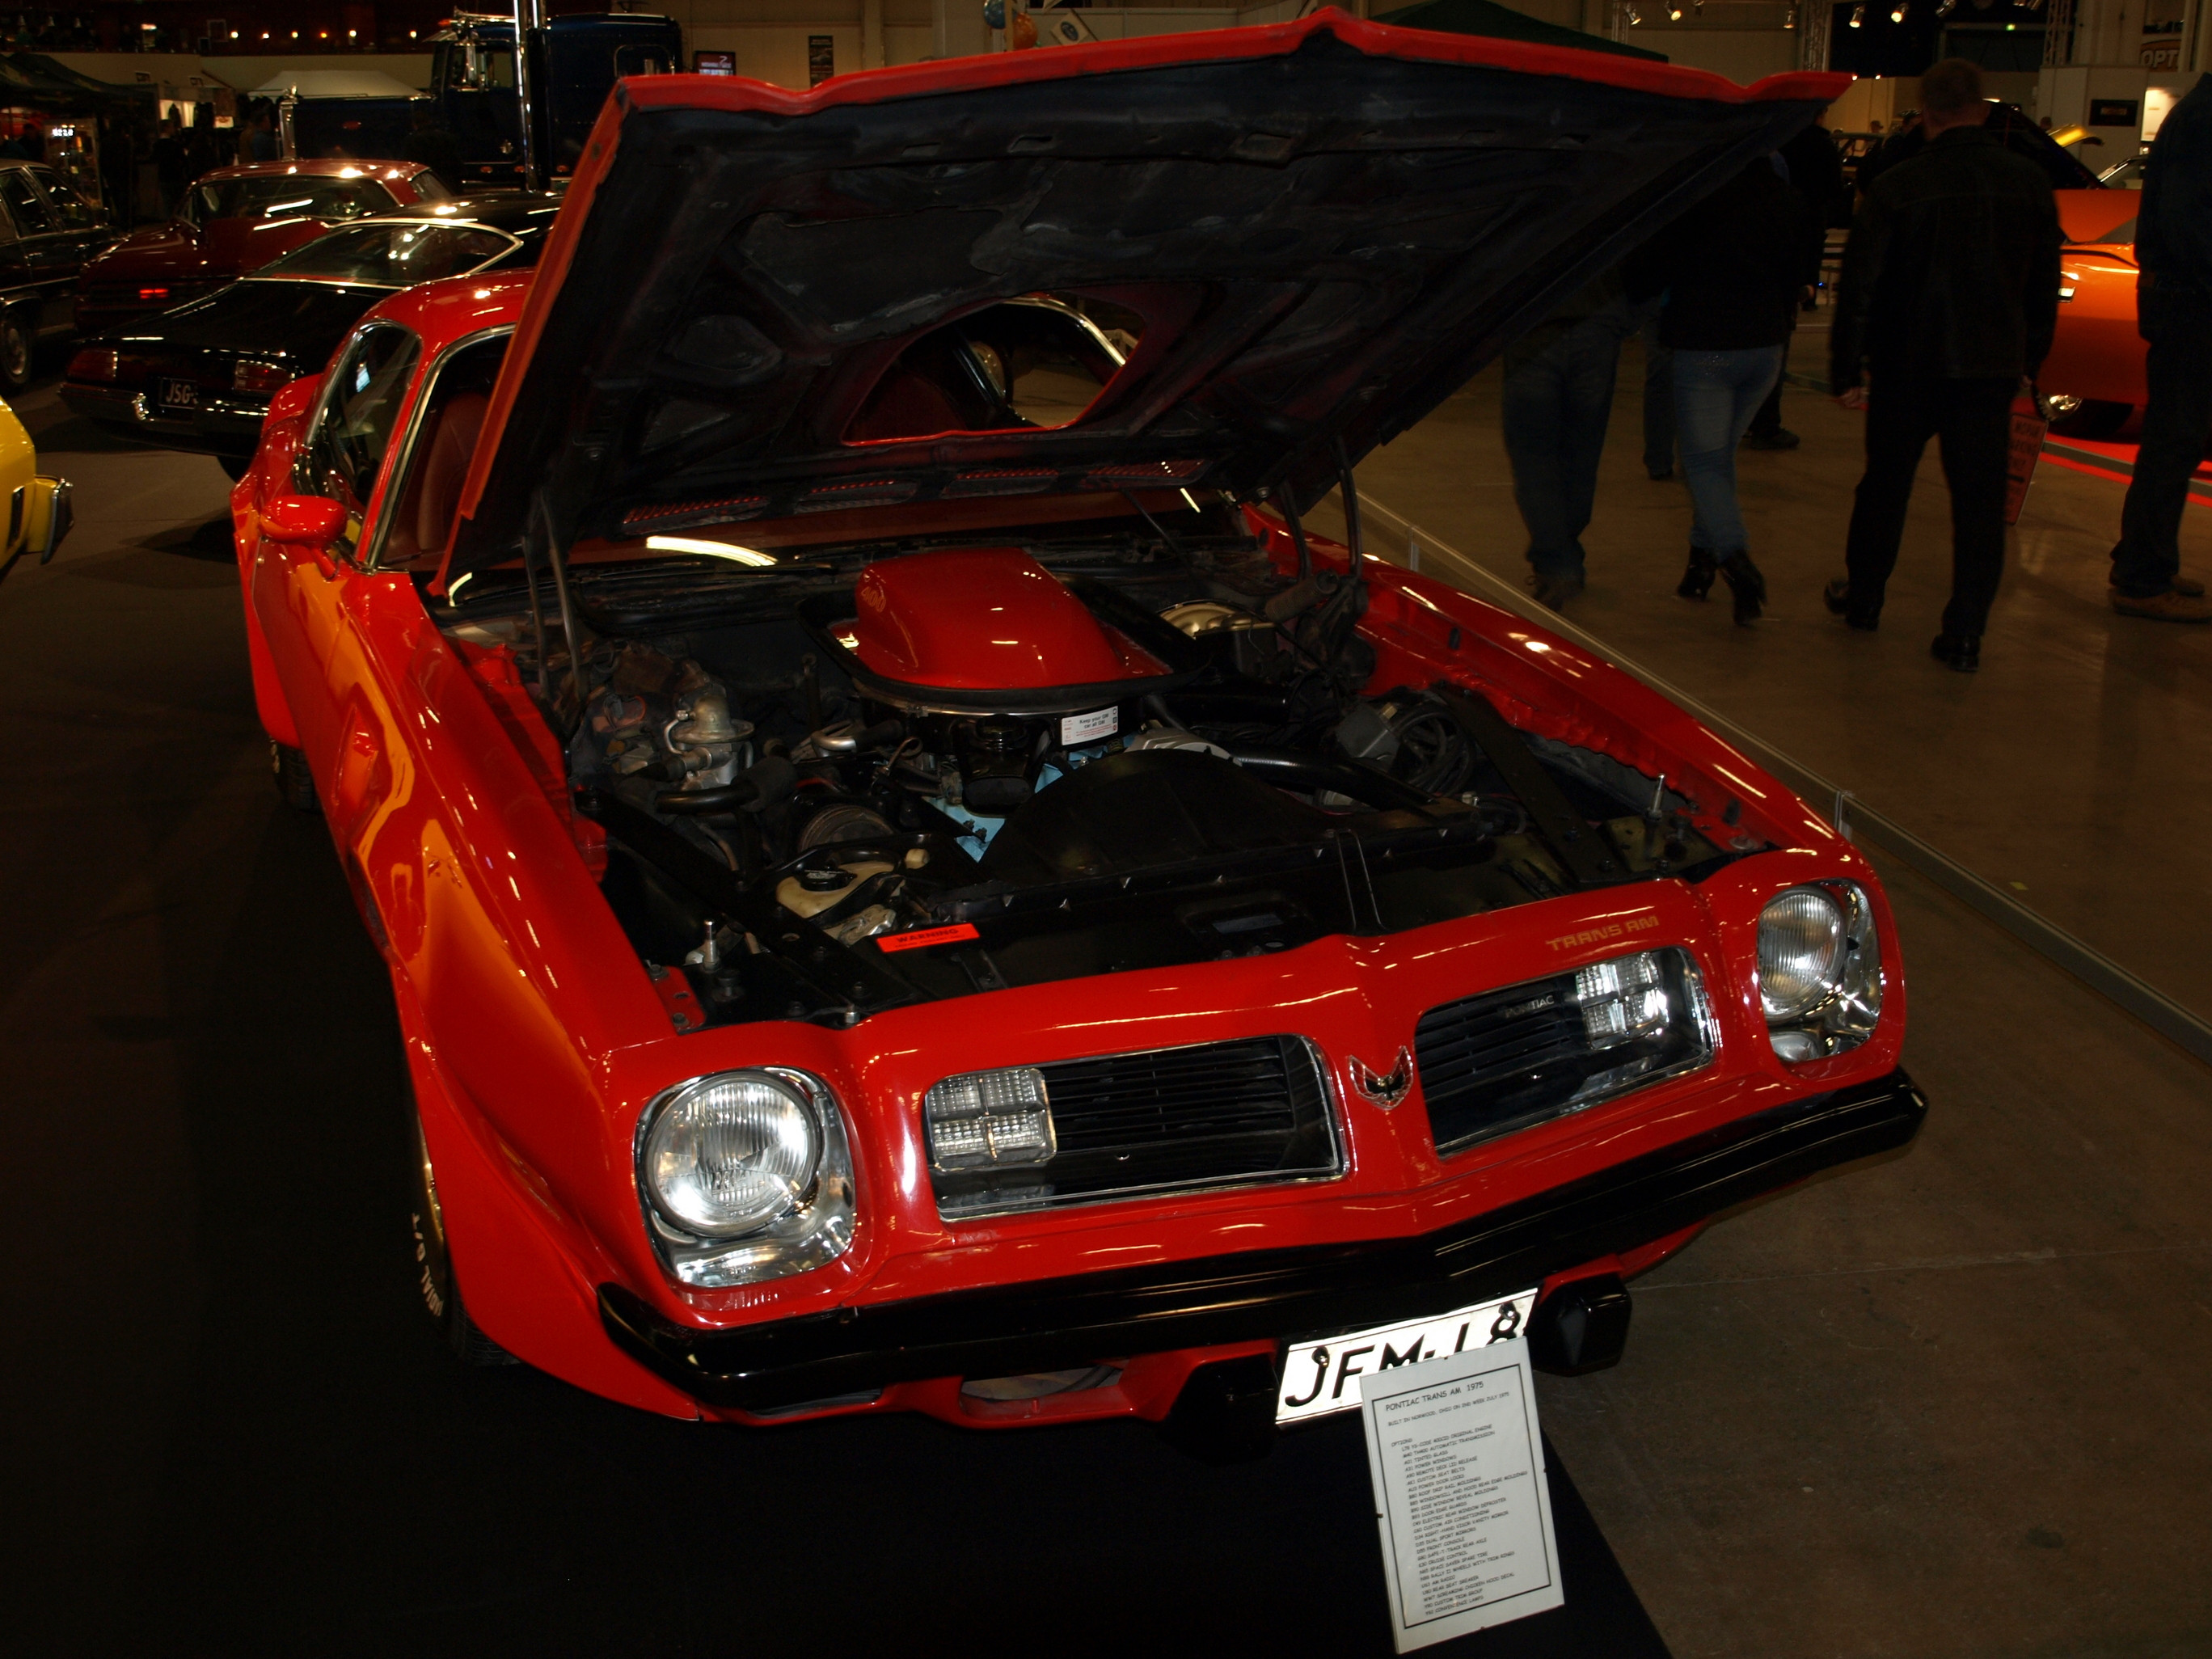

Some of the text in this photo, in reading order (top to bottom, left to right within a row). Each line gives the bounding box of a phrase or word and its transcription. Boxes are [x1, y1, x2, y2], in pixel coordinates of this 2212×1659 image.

[896, 928, 959, 943] WARNING
[1546, 914, 1660, 951] TRANS AM
[1505, 995, 1555, 1018] PONTIAC
[1385, 1380, 1484, 1412] PONTIAC TRANS AM 1975
[1387, 1418, 1402, 1426] BUILT
[1438, 1405, 1452, 1414] OHIO
[1461, 1400, 1471, 1408] 2ND
[1471, 1397, 1484, 1405] WEEK
[1486, 1394, 1497, 1402] JULY
[1450, 1429, 1473, 1439] ORIGINAL
[1474, 1424, 1492, 1433] ENGINE
[1413, 1447, 1429, 1455] TH400
[1429, 1440, 1457, 1451] AUTOMATIC
[1458, 1430, 1495, 1444] TRANSMISSION
[1413, 1453, 1432, 1463] TINTED
[1433, 1449, 1448, 1458] GLASS
[1414, 1460, 1431, 1469] POWER
[1432, 1454, 1457, 1465] WINDOWS
[1415, 1467, 1434, 1476] REMOTE
[1458, 1455, 1477, 1465] RELEASE
[1416, 1473, 1436, 1483] CUSTOM
[1437, 1470, 1449, 1478] SEAT
[1450, 1466, 1465, 1474] BELTS
[1417, 1481, 1434, 1490] POWER
[1435, 1477, 1449, 1485] DOOR
[1450, 1473, 1464, 1481] LOCKS
[1419, 1491, 1450, 1504] WINDOWSILL
[1463, 1484, 1477, 1492] HOOD
[1503, 1471, 1527, 1481] MOLDINGS
[1432, 1485, 1443, 1493] DRIP
[1456, 1475, 1481, 1487] MOLDINGS
[1433, 1496, 1454, 1507] WINDOW
[1455, 1492, 1472, 1501] REVEAL
[1474, 1485, 1498, 1496] MOLDINGS
[1420, 1509, 1434, 1518] DOOR
[1436, 1505, 1447, 1513] EDGE
[1448, 1501, 1467, 1510] GUARDS
[1421, 1513, 1444, 1524] ELECTRIC
[1444, 1510, 1457, 1518] REAR
[1458, 1505, 1479, 1514] WINDOW
[1480, 1497, 1506, 1509] DEFROSTER
[1423, 1522, 1442, 1531] CUSTOM
[1454, 1509, 1489, 1522] CONDITIONING
[1455, 1521, 1471, 1529] VISOR
[1471, 1516, 1489, 1525] VANITY
[1490, 1510, 1509, 1520] MIRROR
[1438, 1532, 1453, 1541] SPORT
[1454, 1526, 1476, 1536] MIRRORS
[1426, 1543, 1442, 1551] FRONT
[1443, 1536, 1464, 1547] CONSOLE
[1462, 1541, 1474, 1549] REAR
[1428, 1556, 1445, 1565] CRUISE
[1446, 1550, 1467, 1560] CONTROL
[1429, 1564, 1444, 1572] SPACE
[1445, 1559, 1460, 1568] SAVER
[1461, 1555, 1475, 1563] SPARE
[1430, 1570, 1444, 1579] RALLY
[1452, 1563, 1471, 1572] WHEELS
[1472, 1559, 1486, 1567] WITH
[1487, 1555, 1499, 1563] TRIM
[1499, 1551, 1514, 1559] RINGS
[1432, 1585, 1445, 1593] REAR
[1445, 1581, 1457, 1589] SEAT
[1458, 1575, 1479, 1585] SPEAKER
[1436, 1586, 1463, 1598] SCREAMING
[1464, 1580, 1485, 1590] CHICKEN
[1485, 1576, 1500, 1584] HOOD
[1500, 1572, 1513, 1580] DECAL
[1440, 1574, 1455, 1583] RADIO
[1433, 1596, 1454, 1606] CUSTOM
[1454, 1592, 1467, 1600] TRIM
[1467, 1588, 1482, 1597] GROUP
[1434, 1599, 1467, 1613] CONVENIENCE
[1468, 1594, 1484, 1603] LAMPS
